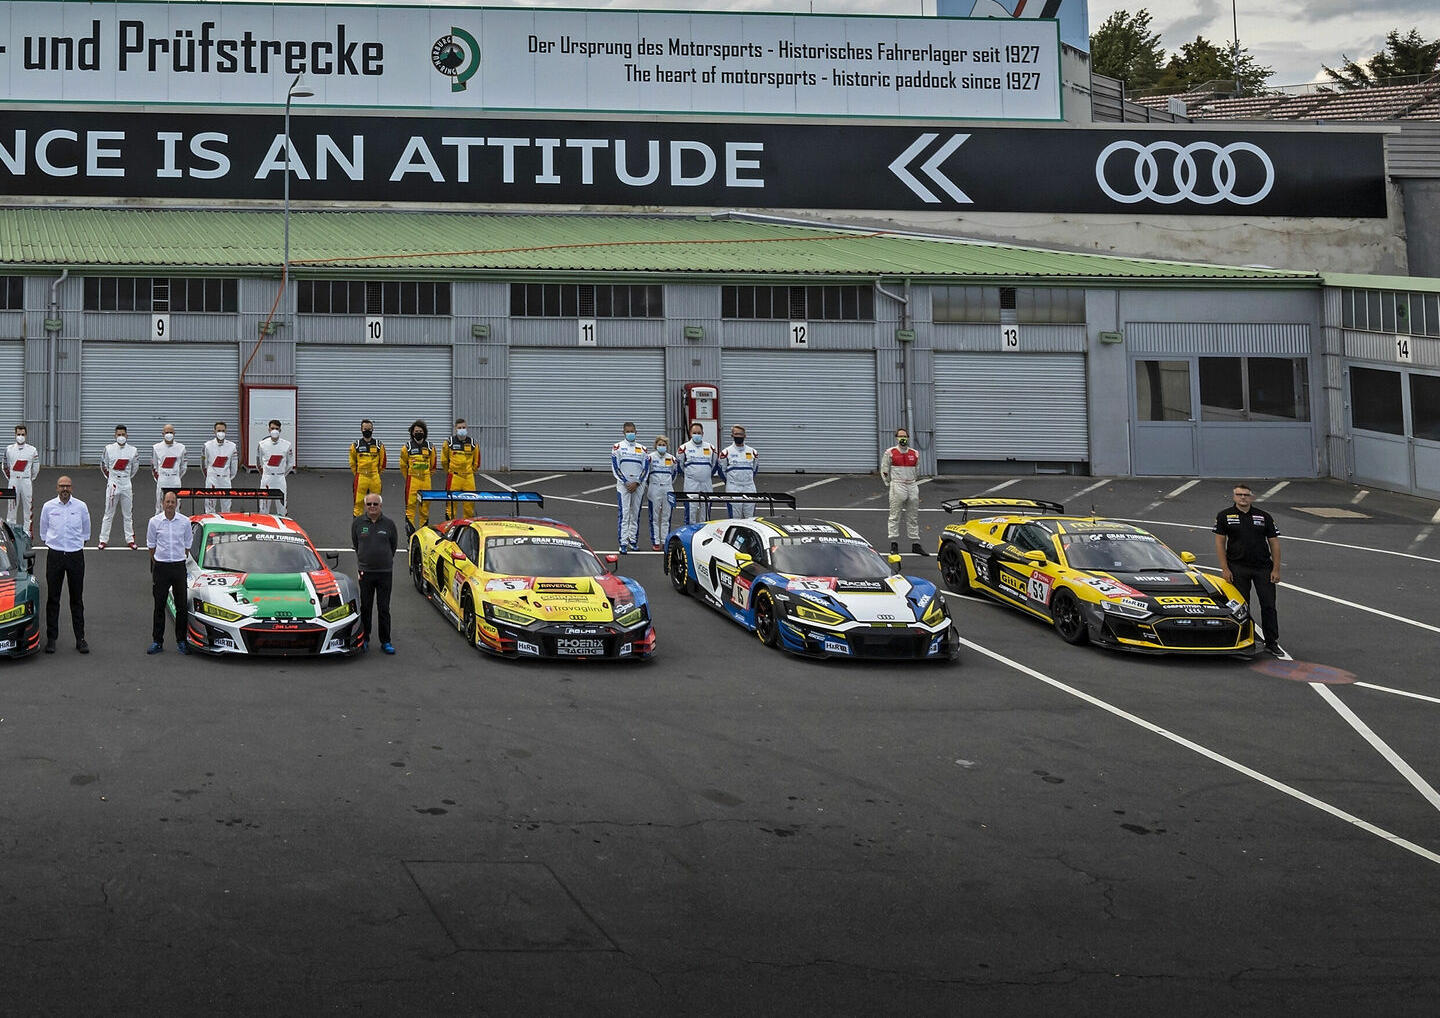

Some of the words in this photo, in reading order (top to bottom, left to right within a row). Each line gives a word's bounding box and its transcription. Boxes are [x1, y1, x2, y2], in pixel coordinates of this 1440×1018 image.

[24, 20, 100, 71] und
[119, 20, 384, 76] Prüfstrecke
[528, 35, 555, 54] Der
[560, 35, 632, 58] Ursprung
[637, 38, 663, 56] des
[668, 38, 762, 60] Motorsports
[778, 40, 873, 61] Historisches
[877, 42, 968, 66] Fahrerlager
[972, 46, 1001, 63] seit
[1005, 45, 1040, 64] 1927
[625, 64, 651, 82] The
[656, 65, 697, 83] heart
[702, 66, 717, 83] of
[721, 67, 816, 88] motorsports
[832, 69, 891, 88] historic
[895, 70, 957, 91] paddock
[962, 73, 1001, 90] since
[1006, 72, 1040, 90] 1927
[156, 131, 231, 179] IS
[253, 134, 364, 181] AN
[389, 136, 765, 188] ATTITUDE
[157, 319, 164, 336] 9
[368, 321, 381, 339] 10
[582, 324, 593, 341] 11
[792, 327, 806, 343] 12
[1004, 329, 1017, 346] 13
[1397, 340, 1409, 358] 14
[276, 535, 306, 543] TURISMO
[552, 538, 583, 548] TURISMO
[207, 577, 227, 586] 29
[504, 582, 515, 590] 5
[720, 571, 732, 586] HFG
[800, 581, 819, 590] 15
[1089, 580, 1117, 592] 53
[1032, 581, 1044, 601] 53
[553, 605, 603, 613] Travaglini
